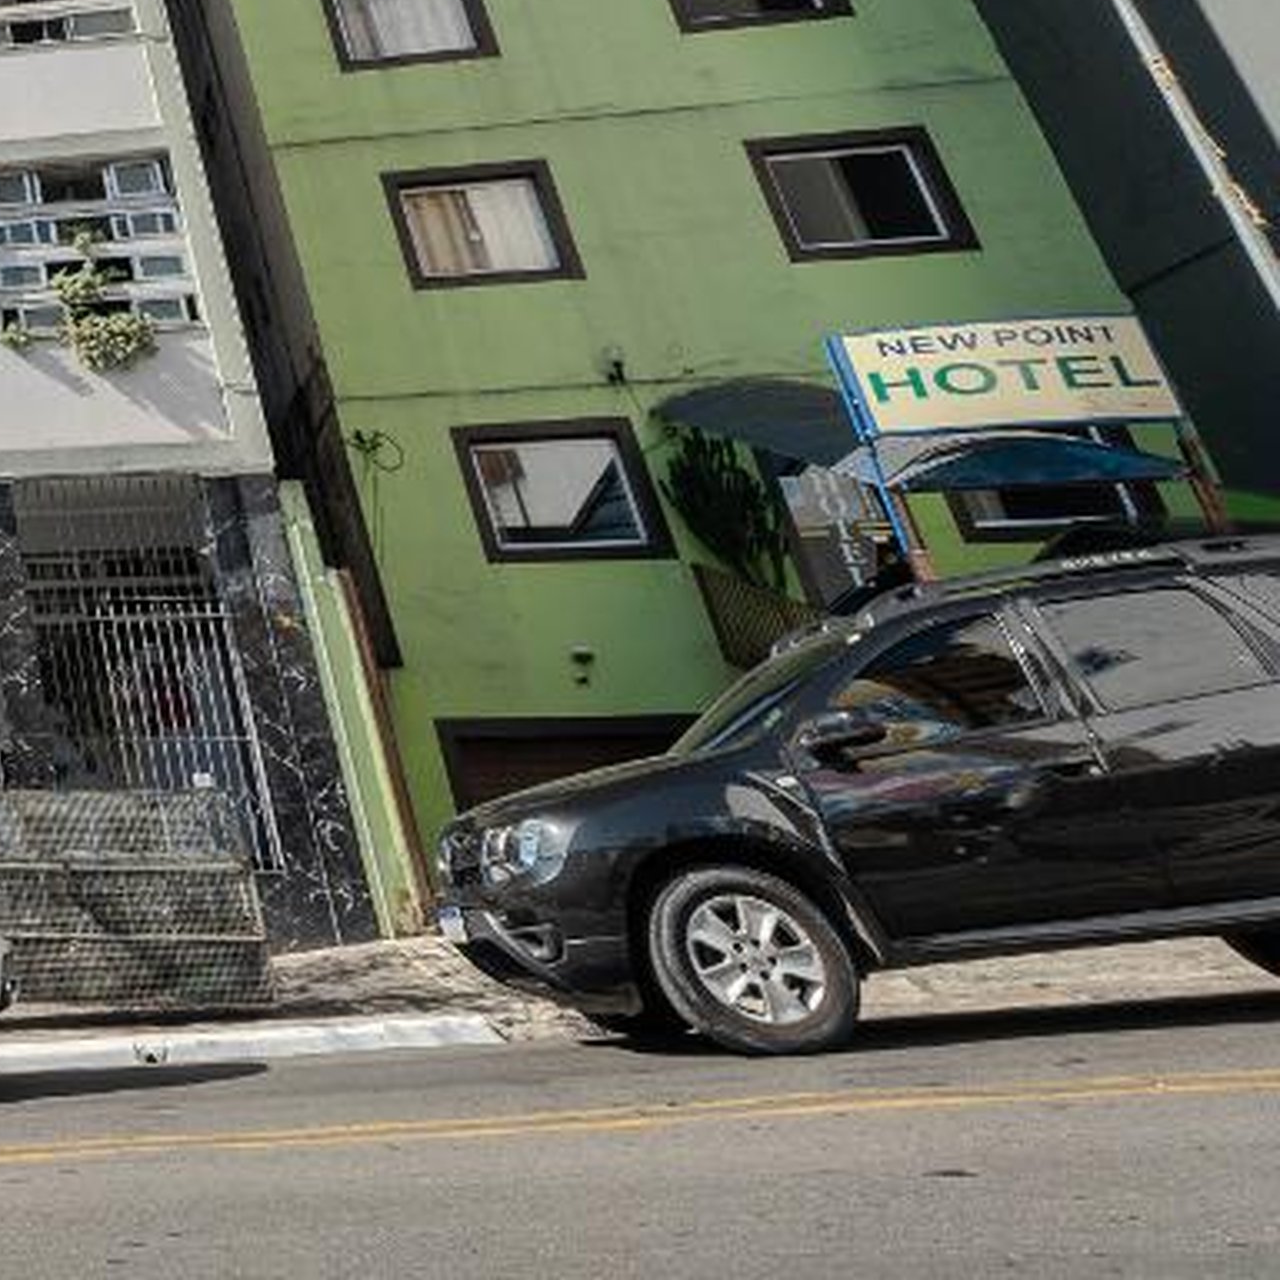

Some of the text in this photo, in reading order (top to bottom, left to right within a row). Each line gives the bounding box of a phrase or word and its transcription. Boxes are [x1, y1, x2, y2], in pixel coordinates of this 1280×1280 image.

[876, 324, 1116, 358] NEW POINT
[867, 354, 1162, 404] HOTEL
